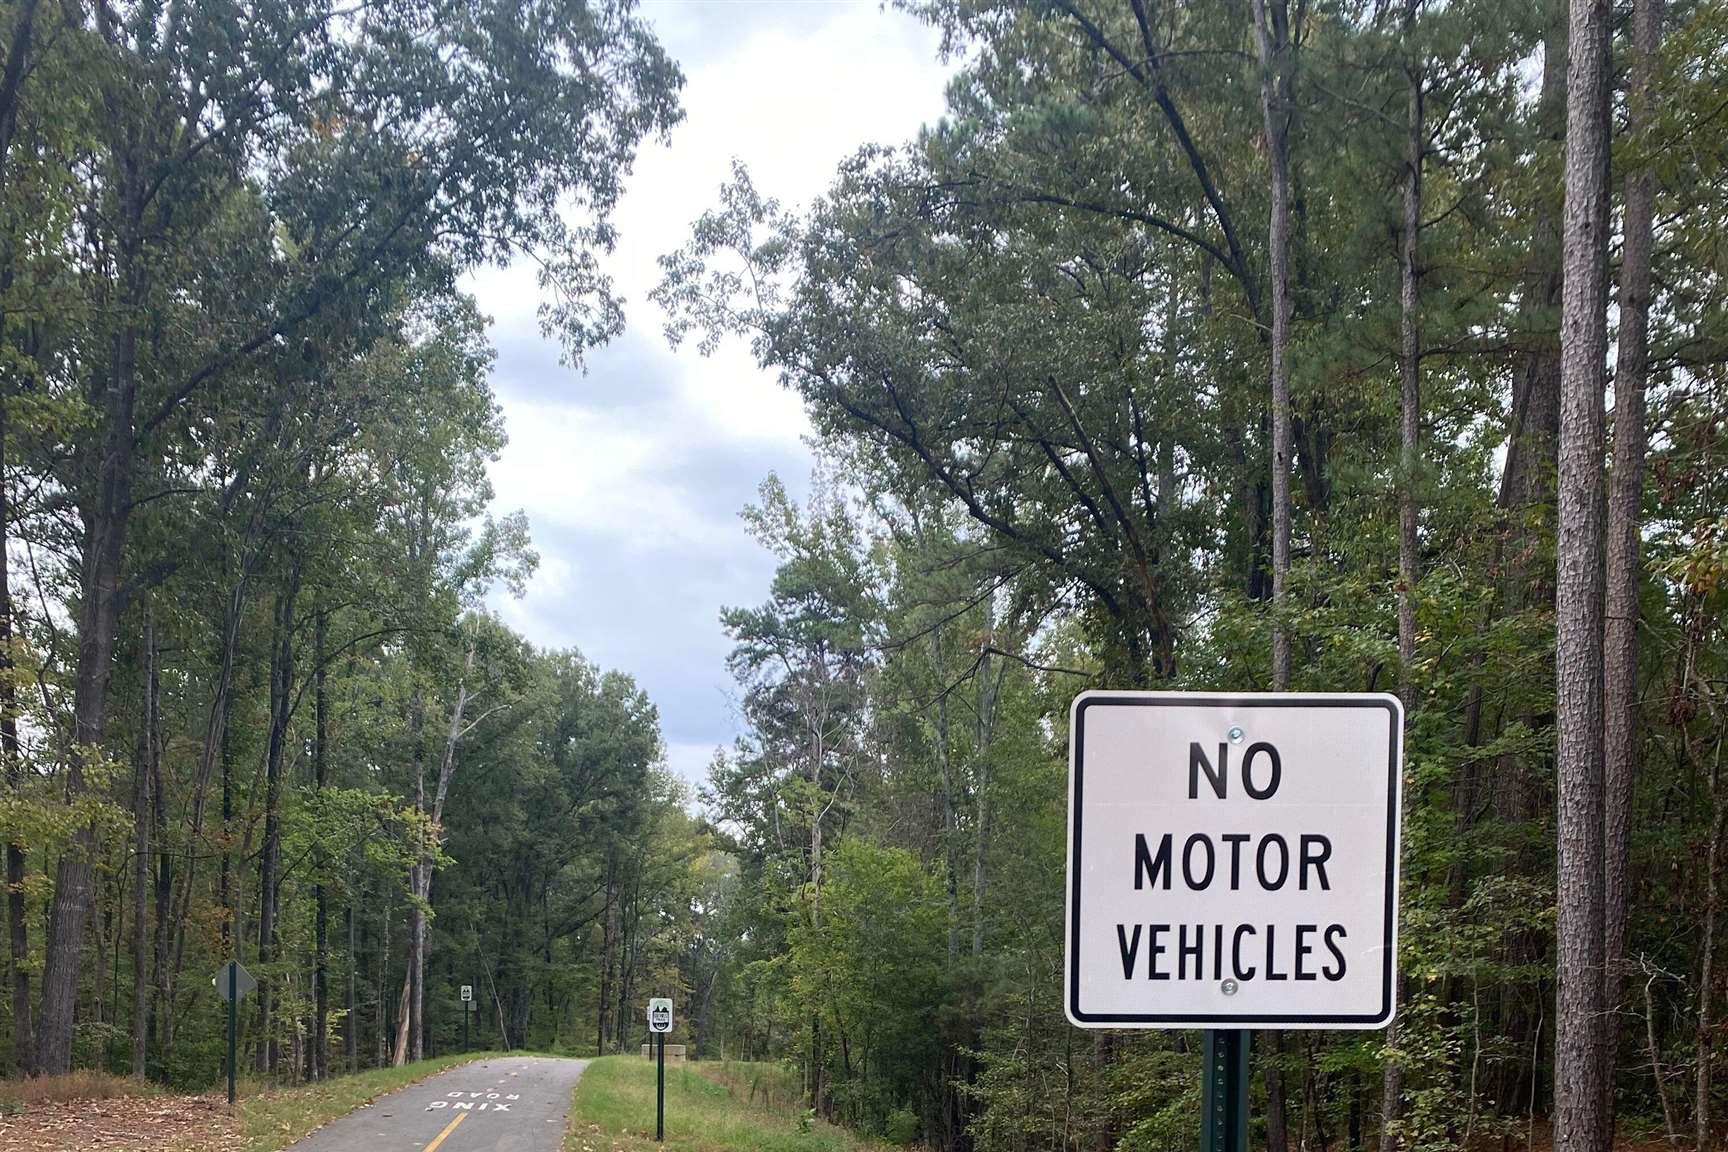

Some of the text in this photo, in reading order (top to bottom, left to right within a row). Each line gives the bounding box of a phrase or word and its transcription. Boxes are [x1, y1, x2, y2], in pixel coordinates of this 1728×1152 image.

[1188, 741, 1281, 800] NO
[1133, 832, 1332, 891] MOTOR
[1116, 923, 1347, 981] VEHICLES
[425, 1101, 512, 1112] XING
[447, 1091, 520, 1100] ROAD
